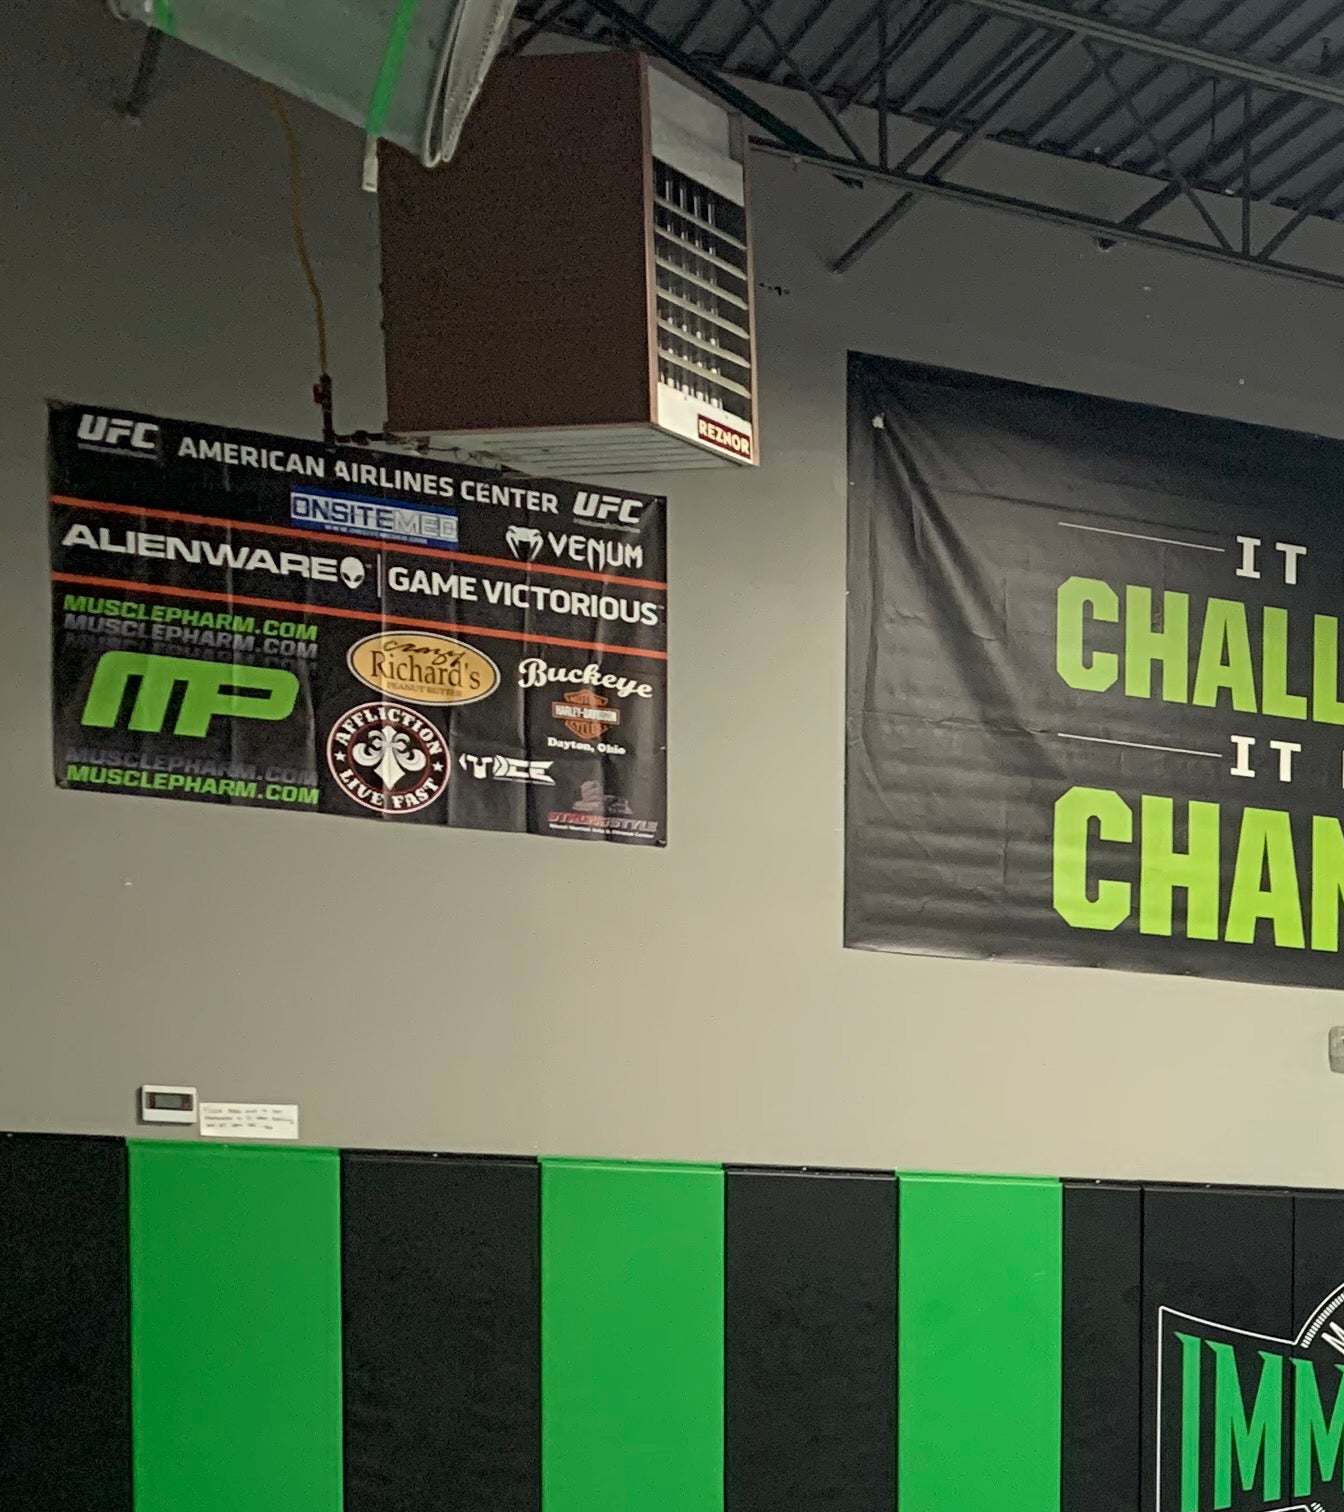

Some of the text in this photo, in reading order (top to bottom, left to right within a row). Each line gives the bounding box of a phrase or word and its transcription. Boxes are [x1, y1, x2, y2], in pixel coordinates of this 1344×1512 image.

[77, 414, 159, 450] UFC
[699, 419, 750, 455] REZNOR
[178, 437, 325, 478] AMERICAN
[334, 460, 454, 498] AIRLINES
[460, 479, 559, 515] CENTER
[573, 491, 644, 524] UFC
[61, 523, 338, 582] ALIENWARE
[548, 531, 644, 571] VENUM
[1235, 535, 1308, 586] IT
[388, 566, 659, 626] GAME VICTORIOUS
[63, 594, 318, 642] MUSCLEPHARM.COM
[63, 613, 319, 659] MUSCLEPHARM.COM
[371, 650, 481, 691] Richard's
[518, 657, 654, 698] Buckeye
[81, 650, 300, 738] MP
[335, 707, 443, 755] AFFLICTION
[597, 743, 626, 755] Ohio
[1230, 734, 1302, 782] IT
[66, 764, 320, 805] MUSCLEPHARM.COM
[339, 769, 439, 809] LIVE FAST
